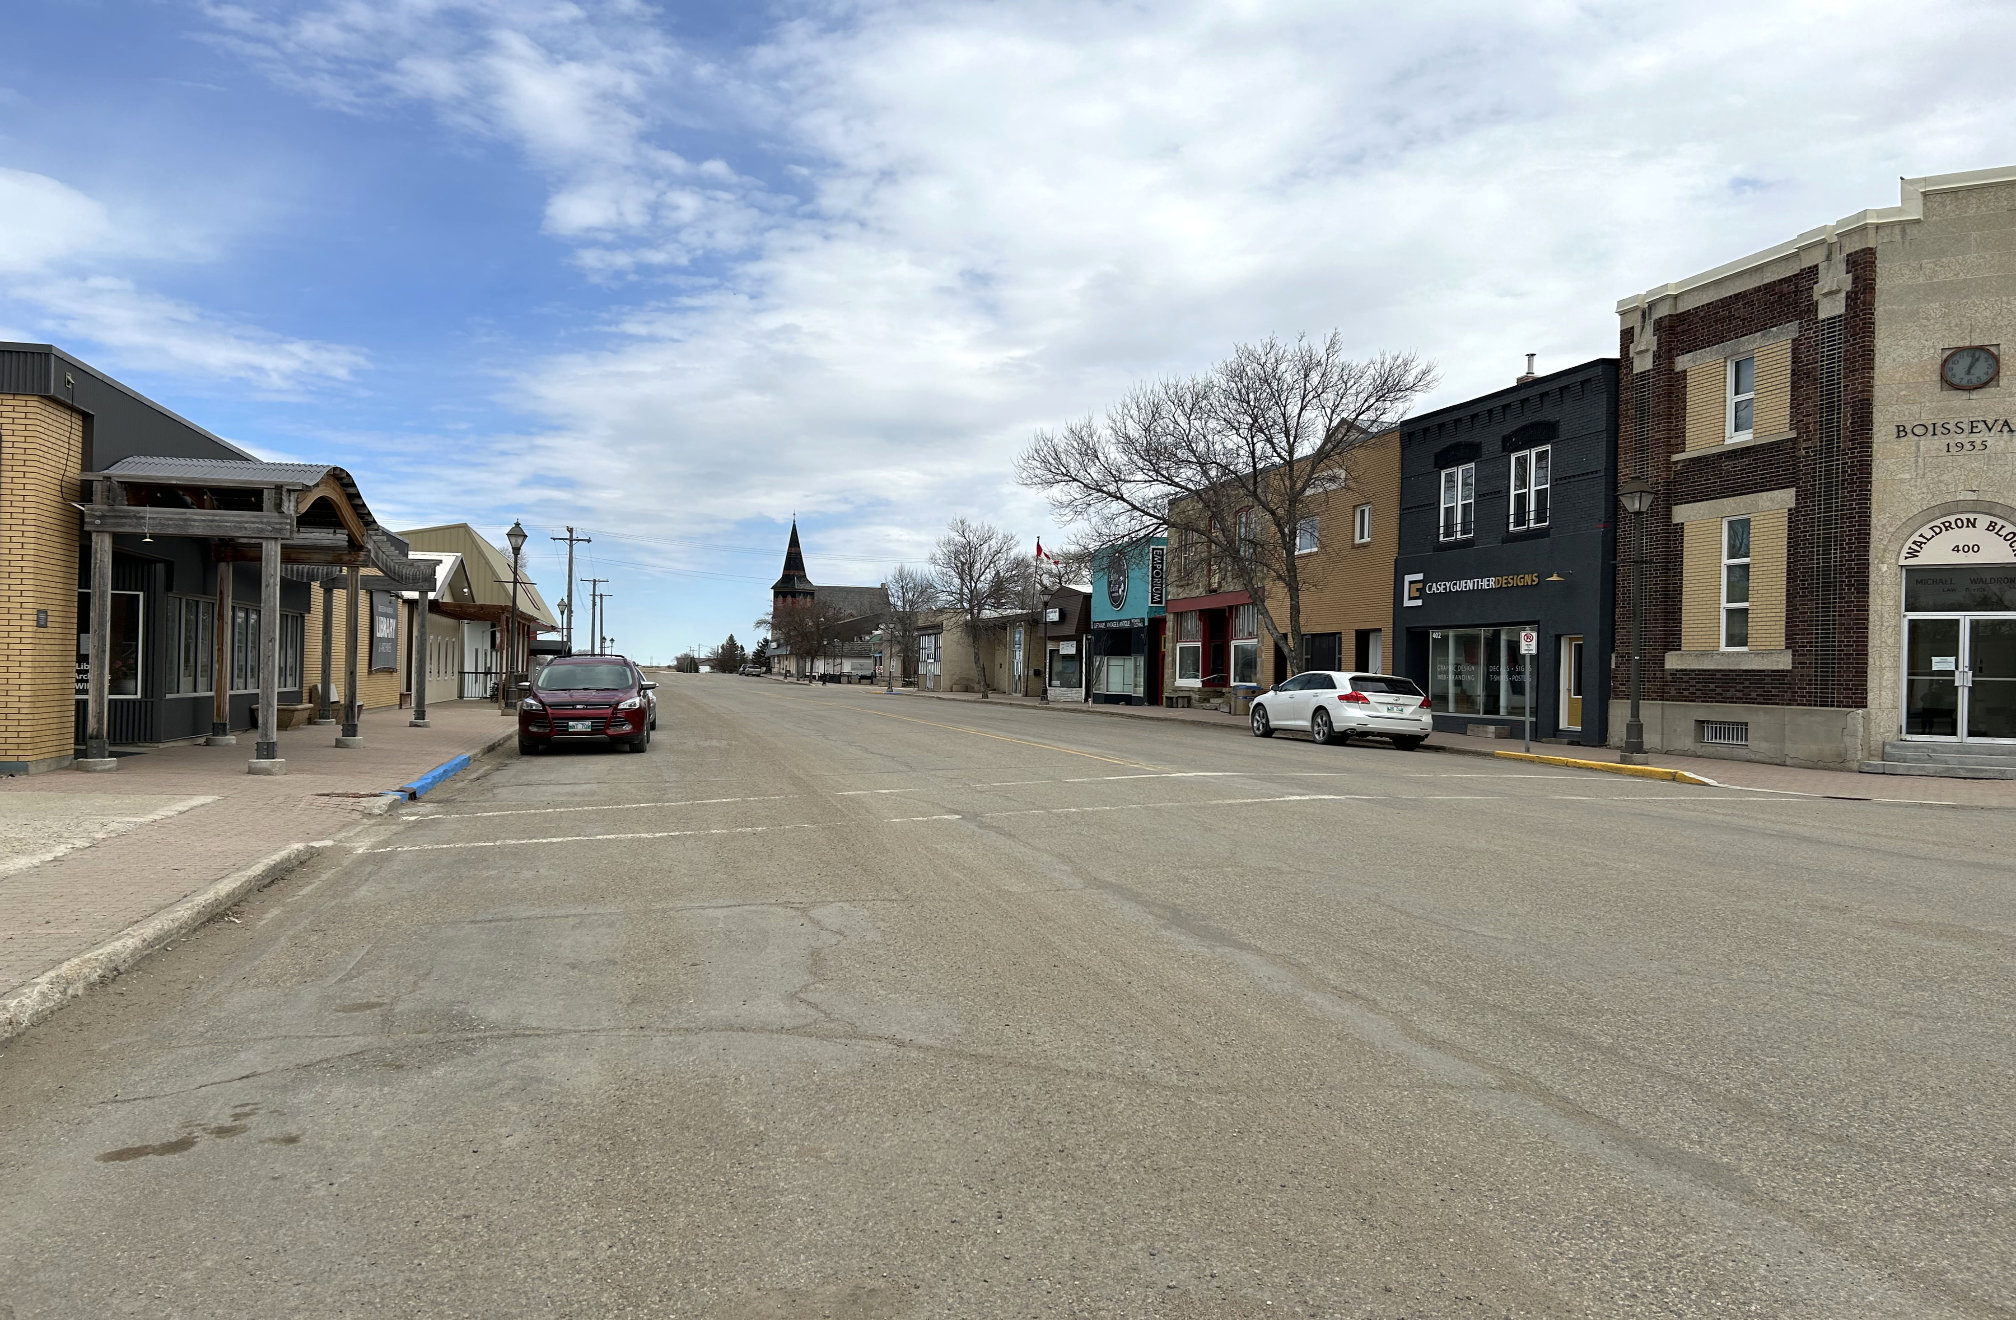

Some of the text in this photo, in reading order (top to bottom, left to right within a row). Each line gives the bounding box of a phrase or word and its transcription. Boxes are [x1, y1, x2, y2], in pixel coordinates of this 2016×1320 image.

[1895, 419, 2016, 438] BOISSEVA
[1946, 440, 1988, 453] 1935
[1904, 517, 1978, 560] WALDRON
[1951, 544, 1980, 553] 400
[1153, 549, 1162, 602] EMPORIUM
[1969, 576, 2016, 585] WALDRON
[376, 615, 396, 638] LIBRARY
[1458, 664, 1475, 672] DESIGN
